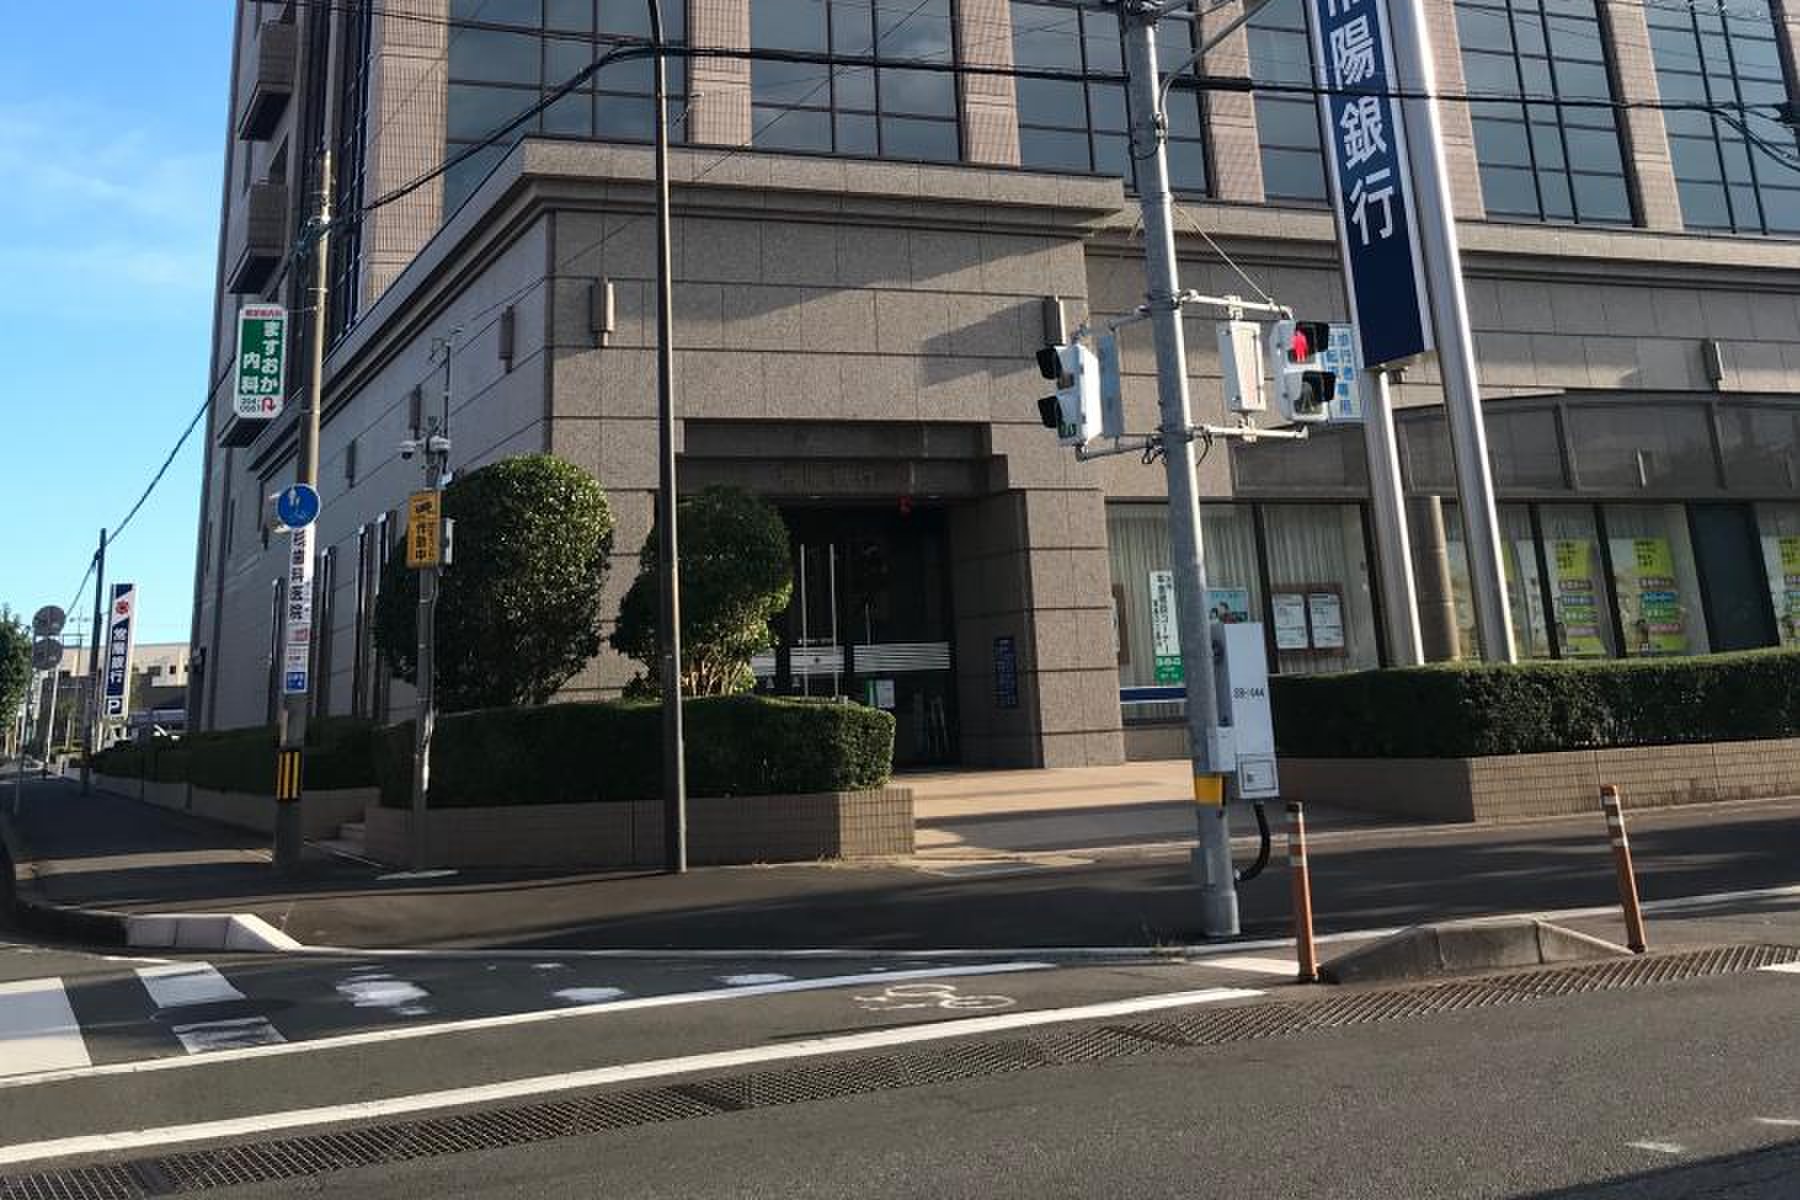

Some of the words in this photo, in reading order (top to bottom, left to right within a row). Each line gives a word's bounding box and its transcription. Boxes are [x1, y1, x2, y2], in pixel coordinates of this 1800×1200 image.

[241, 352, 260, 394] 内科
[260, 321, 281, 393] ますおか
